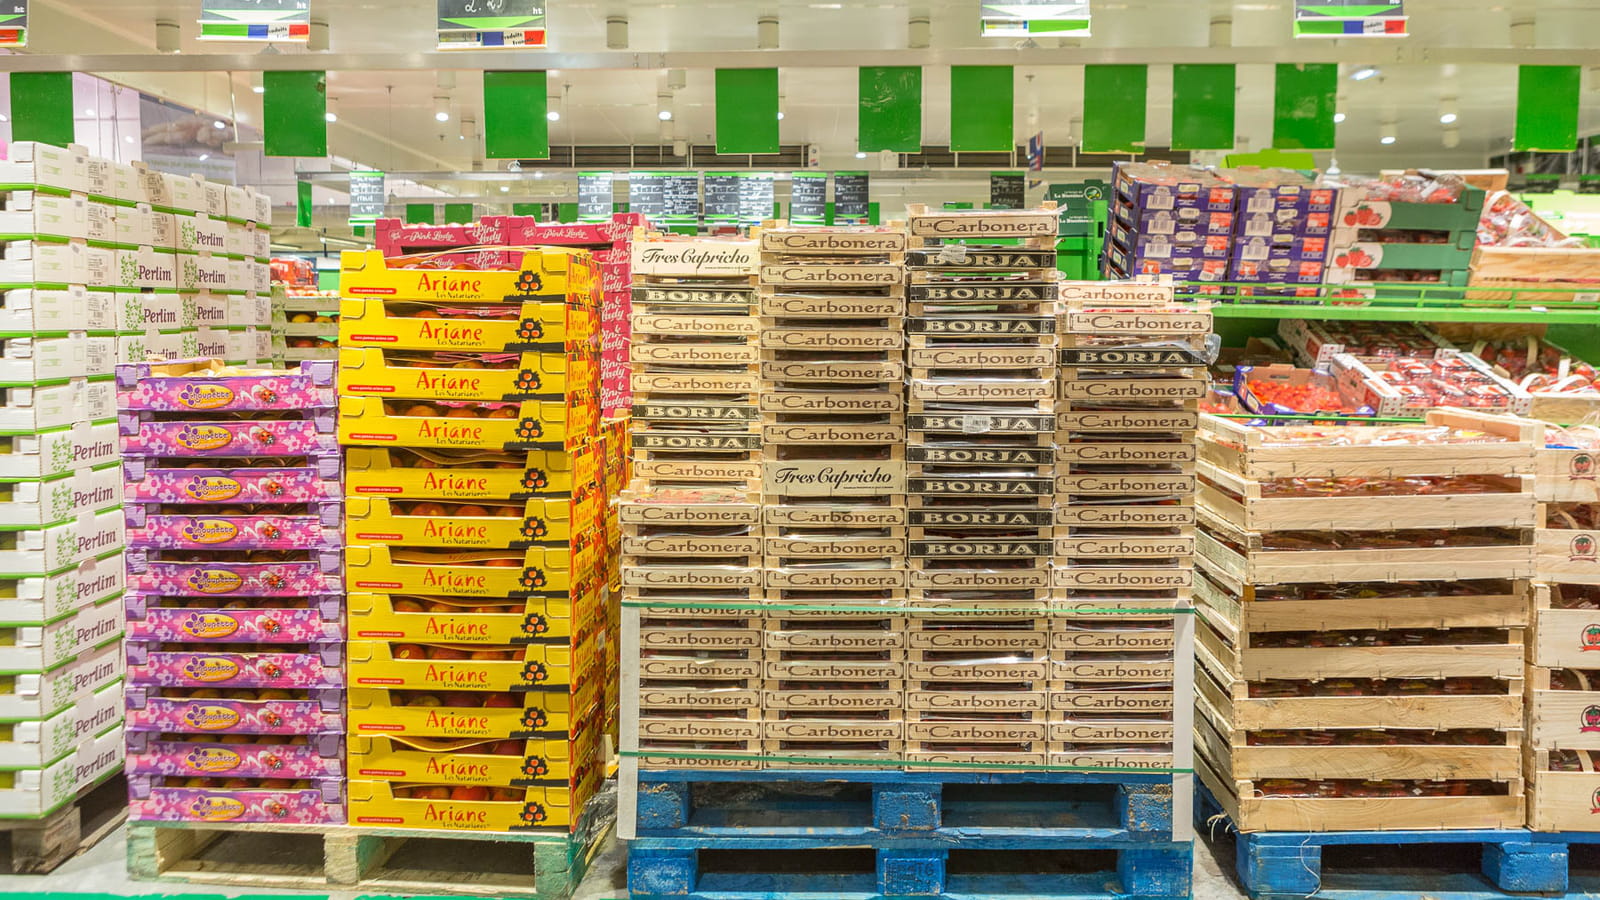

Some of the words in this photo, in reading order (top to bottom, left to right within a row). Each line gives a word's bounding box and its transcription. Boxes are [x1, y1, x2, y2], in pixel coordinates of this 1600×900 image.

[934, 220, 1048, 232] Carbonera
[196, 231, 224, 247] Perlim
[406, 231, 431, 242] Pink
[431, 231, 455, 242] Lady
[541, 226, 568, 240] Pink
[569, 227, 590, 240] Lady
[784, 236, 898, 248] Carbonera
[682, 248, 750, 269] Capricho
[139, 265, 171, 280] Perlim
[199, 269, 225, 283] Perlim
[782, 268, 895, 281] Carbonera
[418, 273, 481, 292] Ariane
[648, 290, 744, 303] BORJA
[929, 288, 1037, 298] BORJA
[1062, 288, 1164, 300] Carbonera
[783, 300, 895, 313] Carbonera
[144, 309, 176, 323] Perlim
[198, 307, 224, 320] Perlim
[653, 318, 753, 331] Carbonera
[926, 321, 1034, 332] BORJA
[1091, 316, 1203, 329] Carbonera
[420, 321, 482, 340] Ariane
[783, 332, 895, 345] Carbonera
[198, 343, 225, 357] Perlim
[650, 347, 750, 359] Carbonera
[934, 352, 1046, 365] Carbonera
[1078, 352, 1186, 362] BORJA
[783, 364, 895, 377] Carbonera
[417, 371, 480, 390] Ariane
[652, 377, 751, 389] Carbonera
[935, 384, 1047, 397] Carbonera
[1086, 384, 1198, 397] Carbonera
[782, 396, 893, 408] Carbonera
[646, 407, 746, 418] BORJA
[1079, 416, 1188, 428] Carbonera
[419, 420, 482, 439] Ariane
[786, 428, 896, 440] Carbonera
[646, 437, 743, 448] BORJA
[73, 441, 113, 462] Perlim
[926, 451, 1034, 462] BORJA
[1078, 447, 1187, 460] Carbonera
[654, 464, 755, 477] Carbonera
[424, 472, 487, 490] Ariane
[818, 467, 891, 489] Capricho
[926, 482, 1034, 492] BORJA
[1077, 478, 1188, 492] Carbonera
[74, 487, 113, 508] Perlim
[643, 507, 752, 520] Carbonera
[788, 510, 897, 523] Carbonera
[924, 513, 1031, 523] BORJA
[1078, 510, 1187, 522] Carbonera
[424, 519, 487, 538] Ariane
[78, 529, 116, 553] Perlim
[644, 540, 752, 553] Carbonera
[788, 540, 898, 554] Carbonera
[1077, 541, 1186, 554] Carbonera
[926, 544, 1034, 554] BORJA
[424, 568, 486, 587] Ariane
[646, 571, 753, 584] Carbonera
[788, 572, 898, 585] Carbonera
[931, 573, 1040, 585] Carbonera
[1075, 572, 1184, 585] Carbonera
[77, 575, 116, 599] Perlim
[76, 617, 116, 645] Perlim
[426, 617, 488, 635] Ariane
[645, 632, 753, 645] Carbonera
[788, 634, 898, 647] Carbonera
[930, 634, 1040, 646] Carbonera
[1074, 634, 1174, 647] Carboner
[425, 664, 488, 683] Ariane
[645, 663, 752, 675] Carbonera
[75, 663, 114, 692] Perlim
[645, 693, 752, 705] Carbonera
[786, 693, 894, 706] Carbonera
[930, 695, 1038, 708] Carbonera
[1072, 696, 1173, 708] Carboner
[75, 705, 115, 738] Perlim
[426, 710, 488, 728] Ariane
[646, 722, 751, 736] Carbonera
[75, 749, 115, 783] Perlim
[426, 757, 488, 775] Ariane
[424, 804, 487, 822] Ariane
